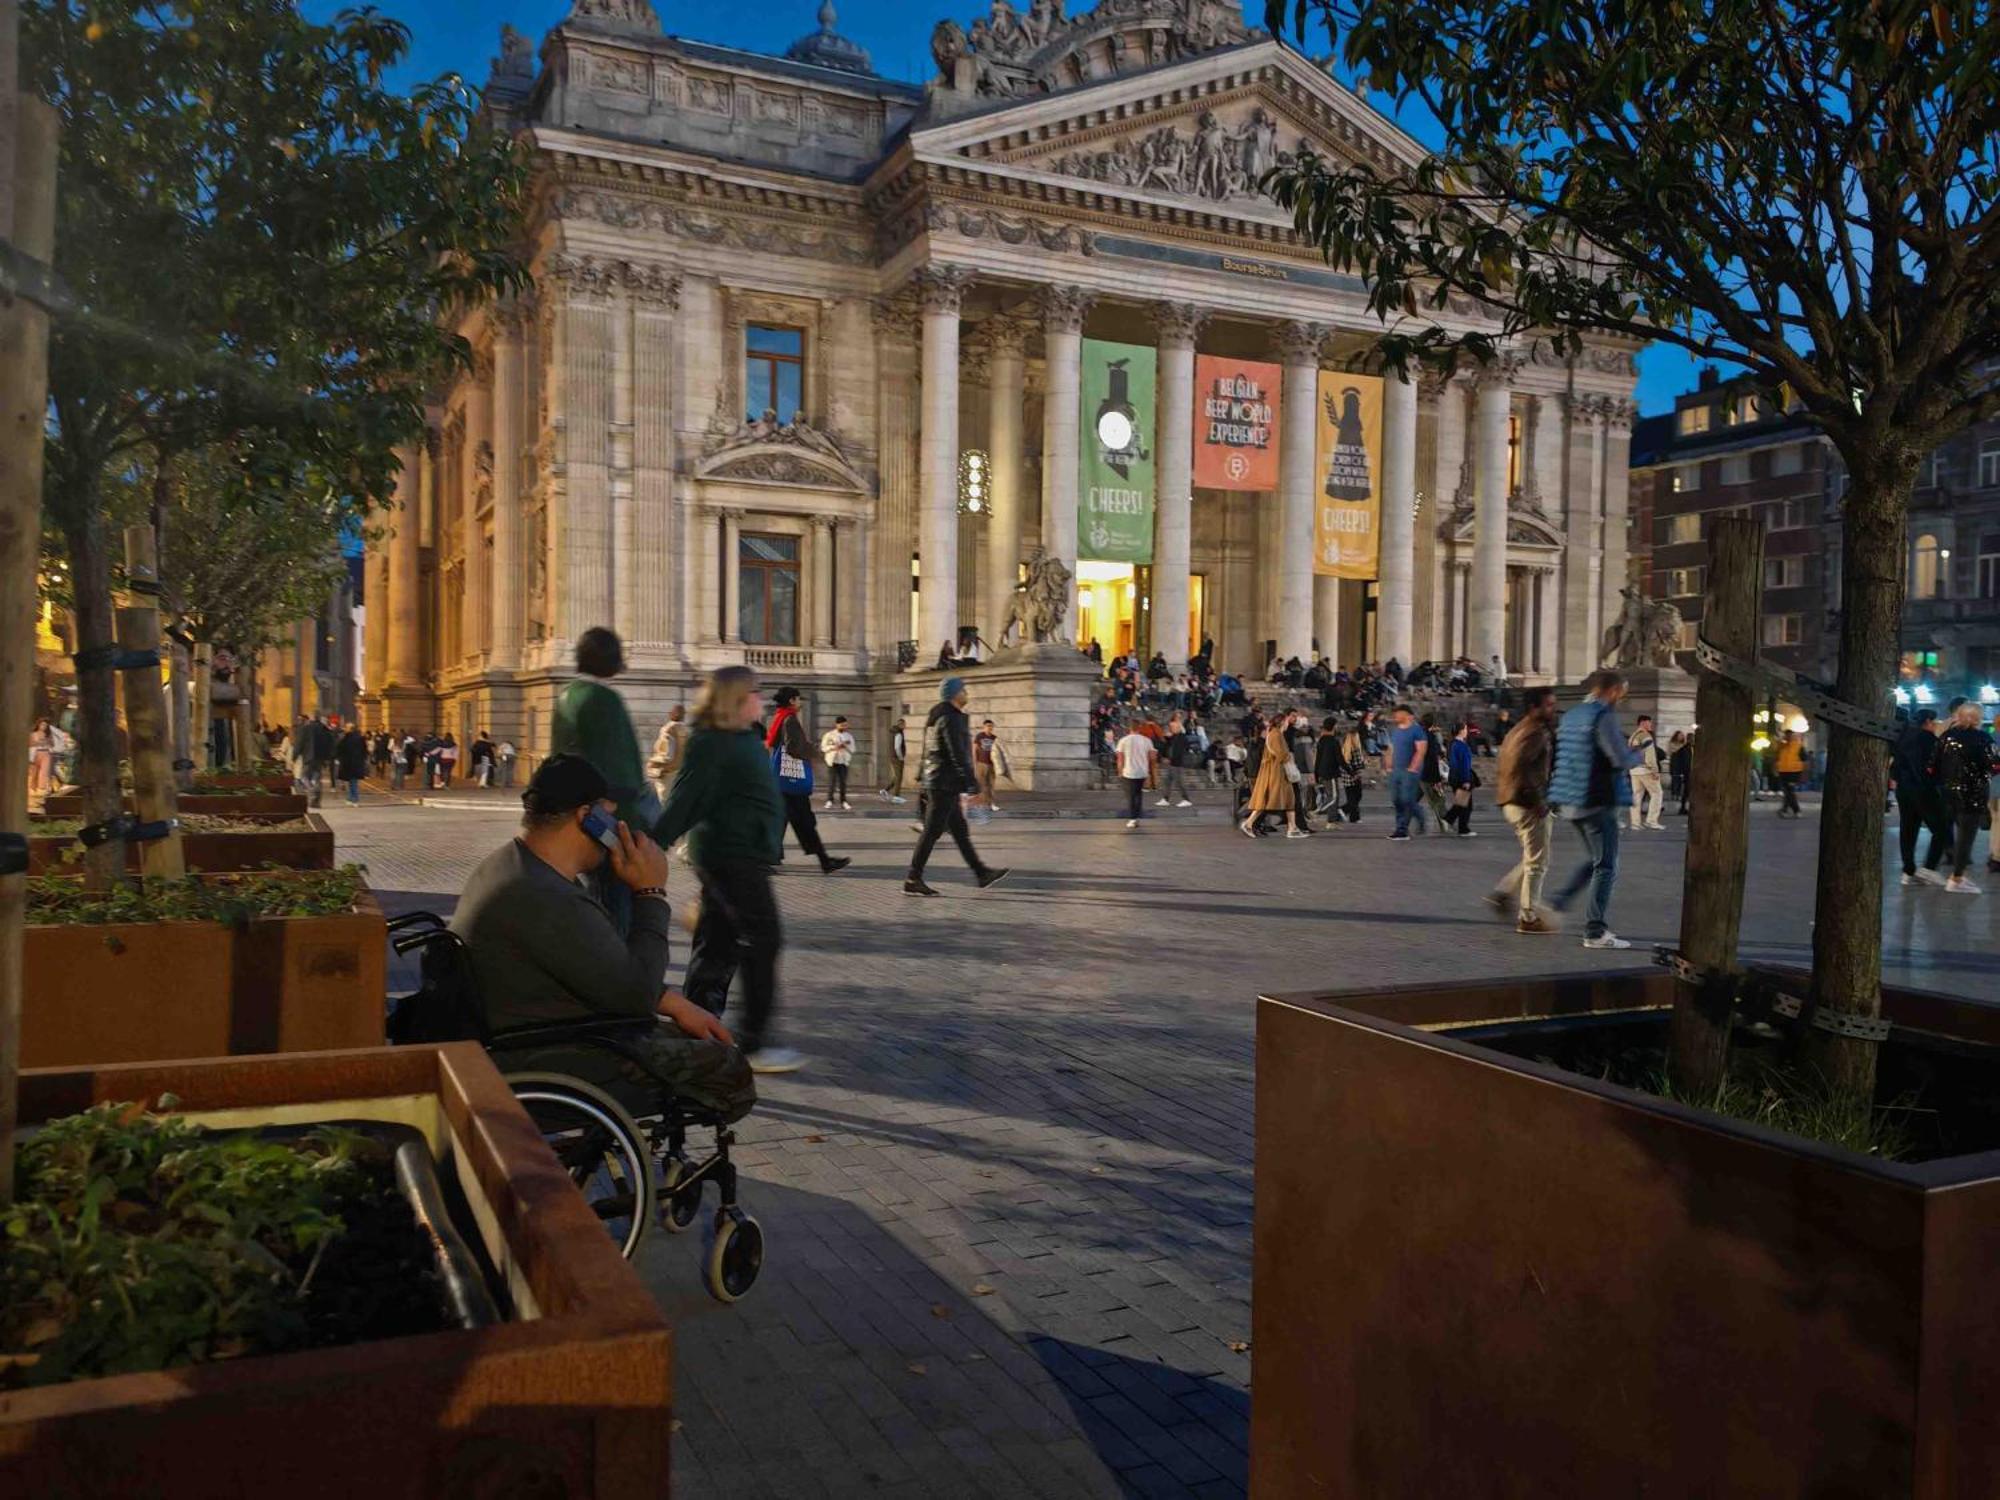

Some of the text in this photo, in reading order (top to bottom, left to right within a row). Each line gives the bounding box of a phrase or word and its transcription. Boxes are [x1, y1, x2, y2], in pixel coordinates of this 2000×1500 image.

[1220, 377, 1259, 399] BELGIAN
[1205, 398, 1272, 424] BEER WORLD
[1209, 421, 1266, 446] EXPERIENCE
[1089, 486, 1143, 515] CHEERS!
[1323, 507, 1370, 534] CHEERS!
